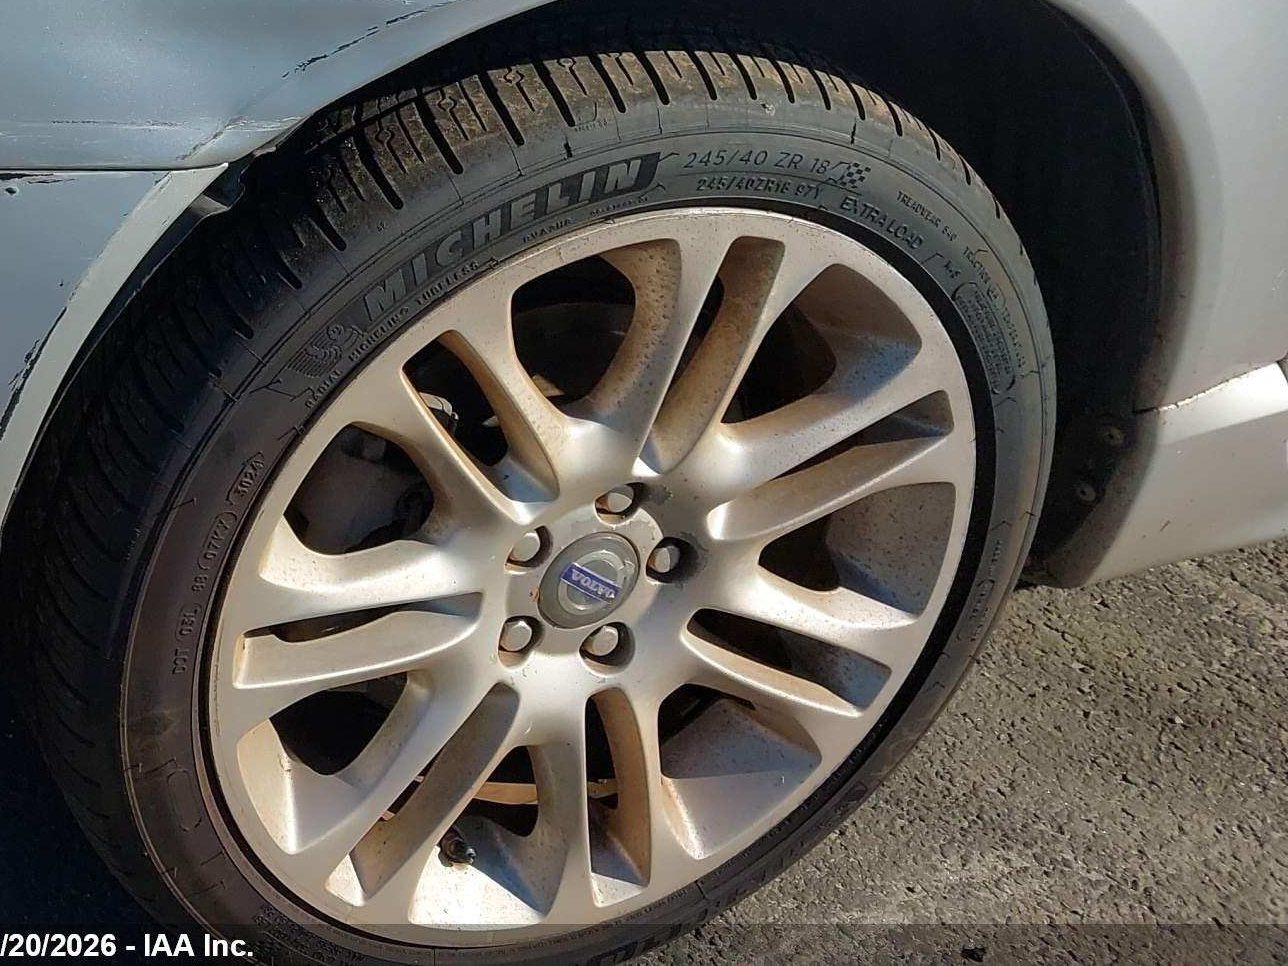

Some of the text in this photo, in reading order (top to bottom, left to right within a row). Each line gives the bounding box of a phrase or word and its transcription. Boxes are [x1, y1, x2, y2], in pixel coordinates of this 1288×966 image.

[683, 149, 830, 174] 245/40 ZR 18
[363, 158, 642, 322] MICHELIN
[569, 568, 616, 599] VOLVO
